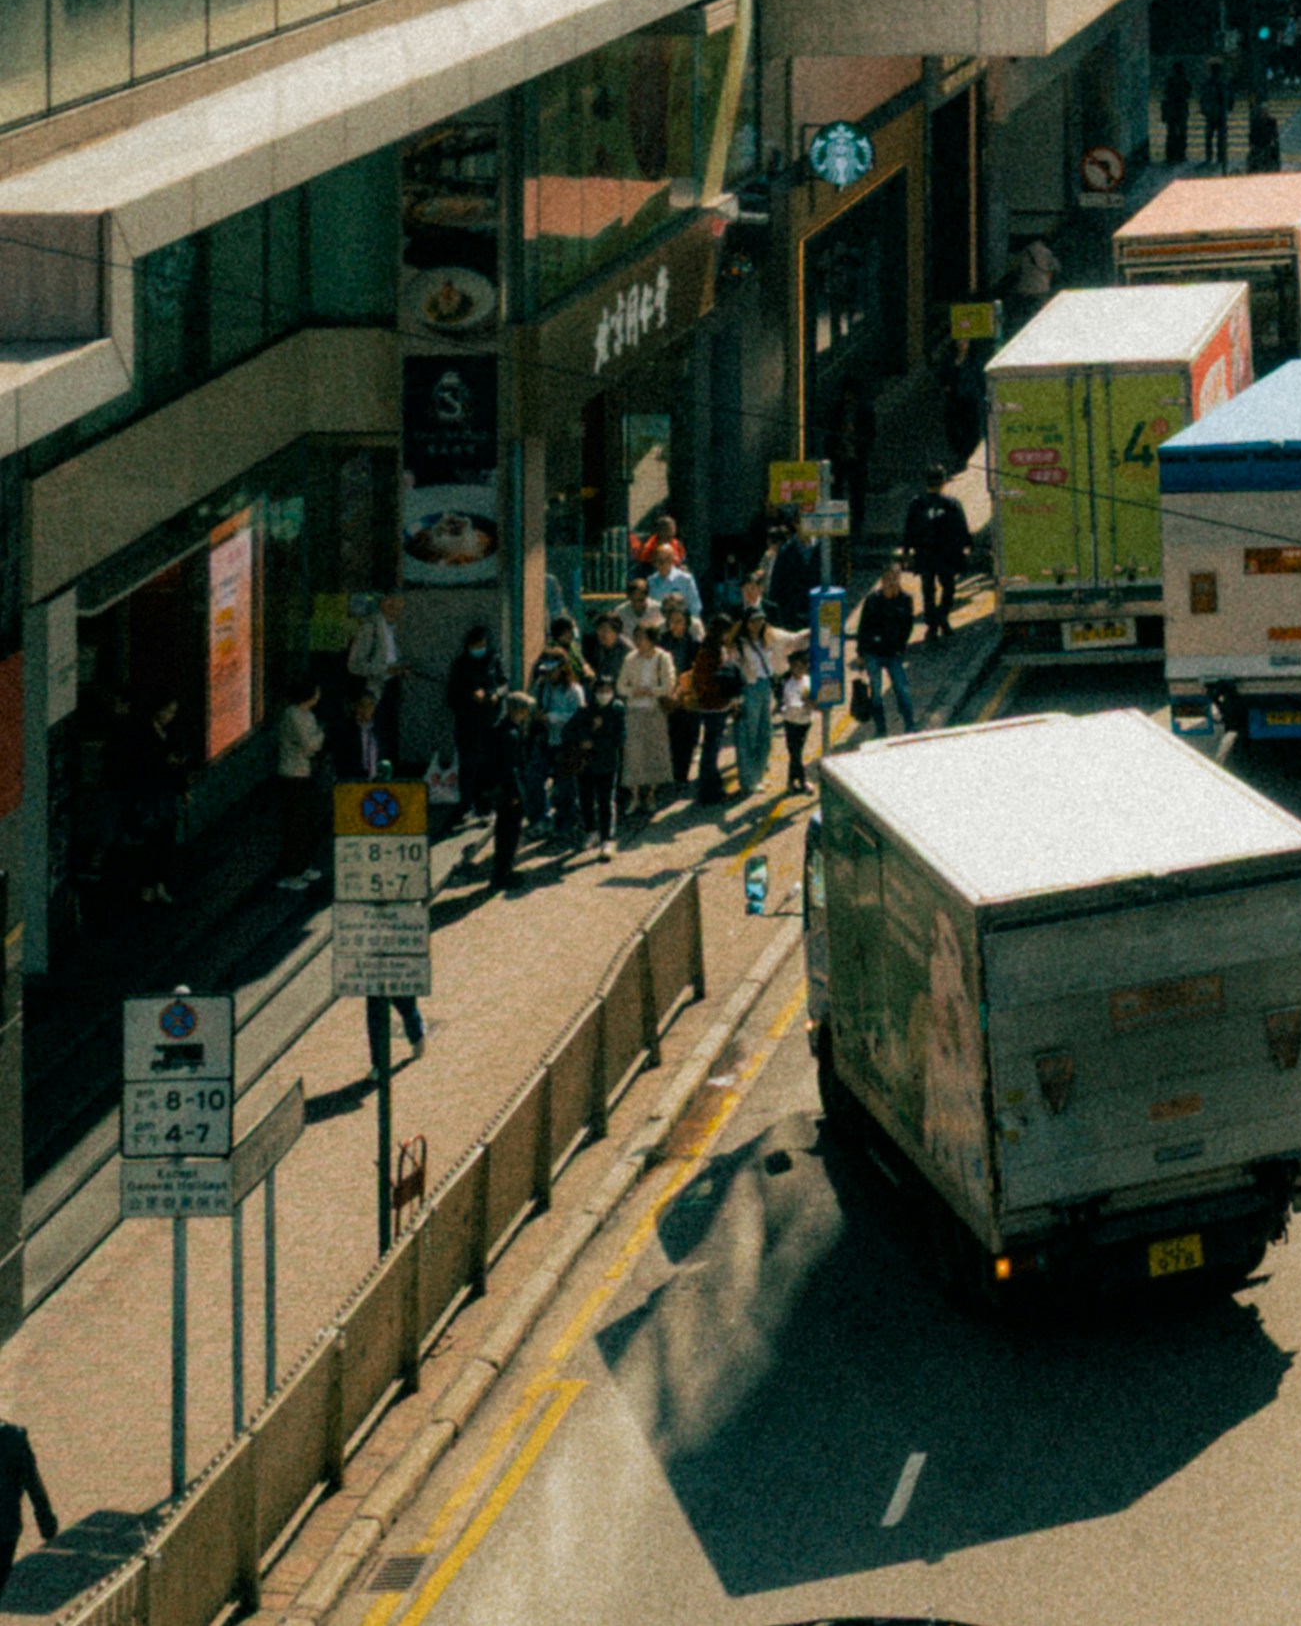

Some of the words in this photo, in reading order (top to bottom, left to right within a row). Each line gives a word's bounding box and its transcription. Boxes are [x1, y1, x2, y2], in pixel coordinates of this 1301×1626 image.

[368, 843, 422, 862] 8-10
[370, 874, 409, 893] 5-7
[165, 1089, 225, 1112] 8-10
[165, 1124, 210, 1144] 4-7
